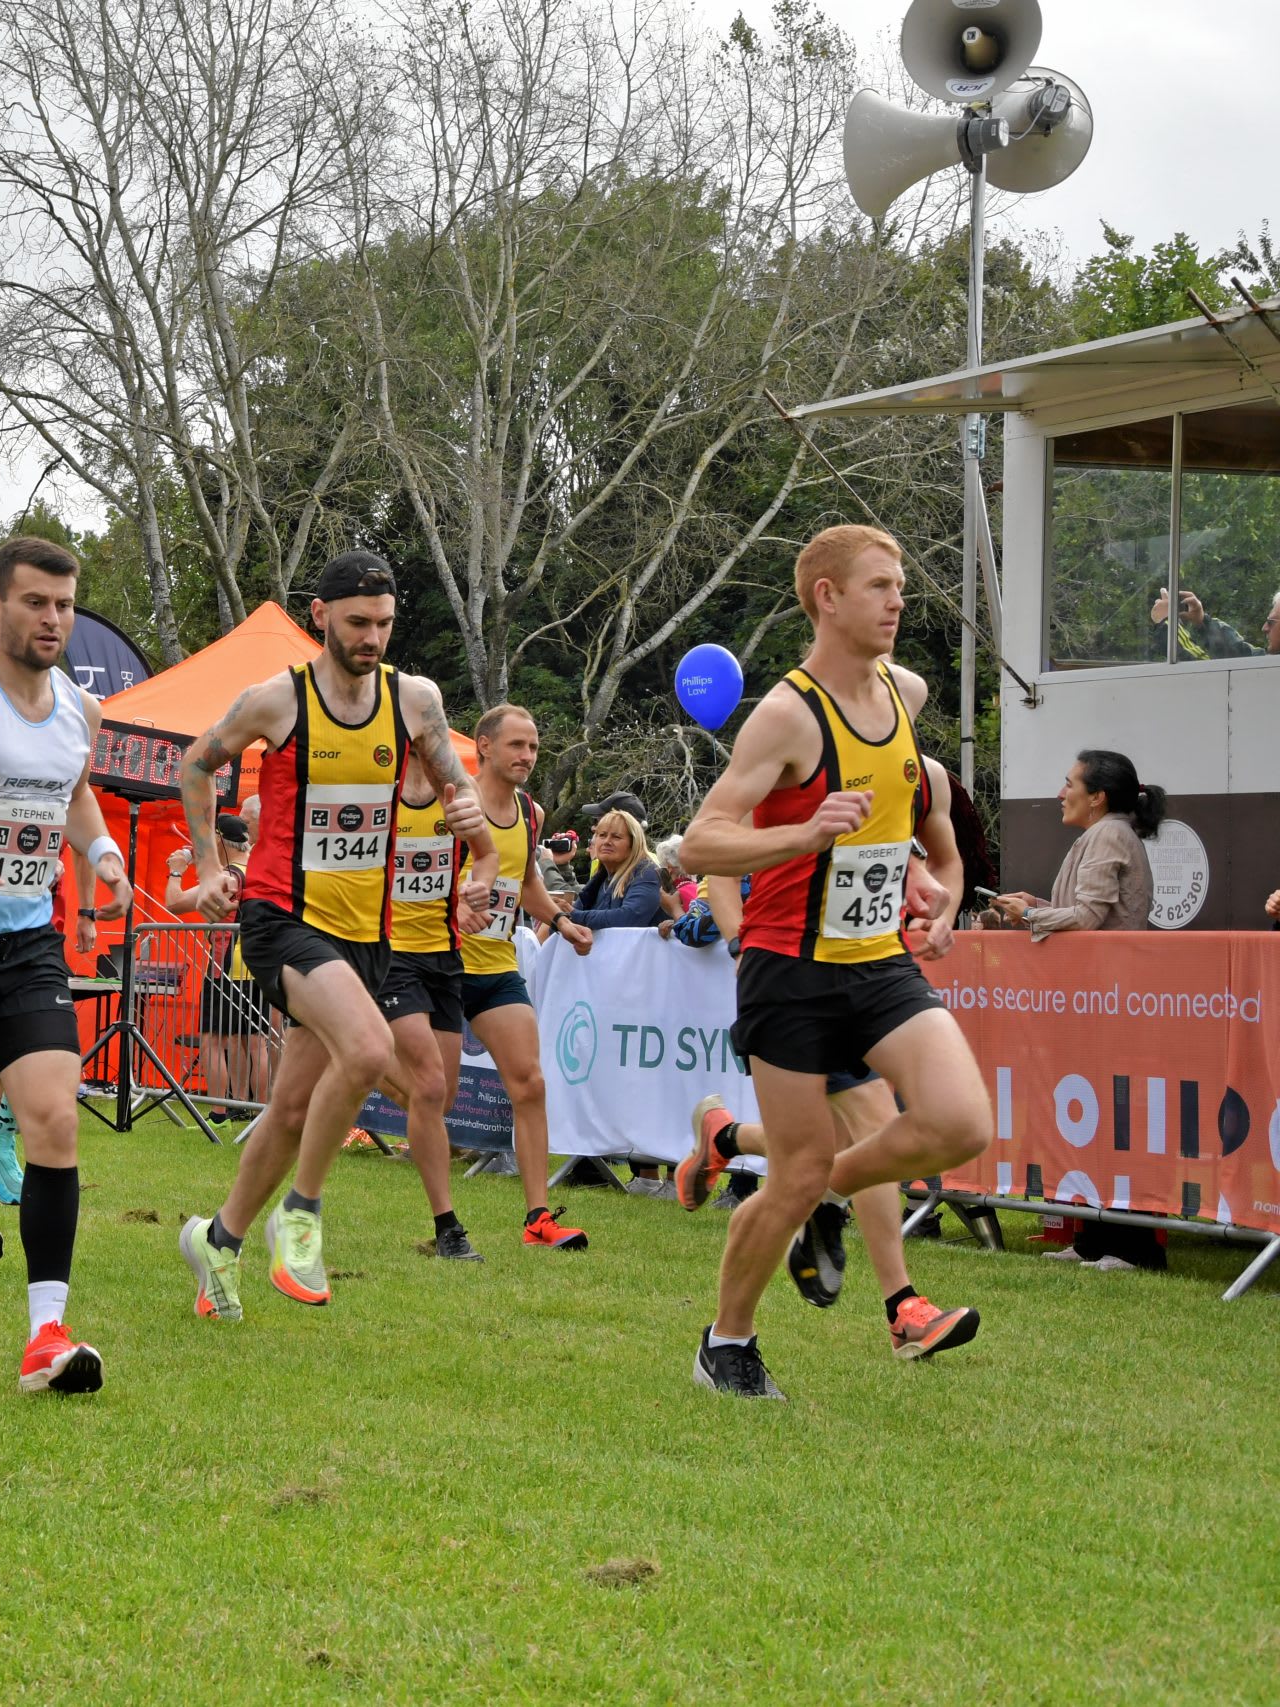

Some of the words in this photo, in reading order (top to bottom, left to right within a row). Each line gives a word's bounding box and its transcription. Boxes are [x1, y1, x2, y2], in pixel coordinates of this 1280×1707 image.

[681, 675, 713, 687] Phillips
[687, 688, 707, 696] Law
[311, 750, 342, 760] soar
[3, 777, 73, 792] REFLEX
[845, 773, 874, 789] soar
[11, 808, 55, 820] STEPHEN
[316, 835, 379, 861] 1344
[858, 847, 899, 860] ROBERT
[396, 873, 445, 894] 1434
[1156, 885, 1182, 895] FLEET
[1166, 871, 1204, 921] 625305
[841, 892, 893, 927] 455
[992, 983, 1066, 1014] secure
[1072, 983, 1119, 1015] and
[1126, 982, 1262, 1023] connected
[612, 1024, 665, 1069] TD
[675, 1026, 747, 1074] SYN
